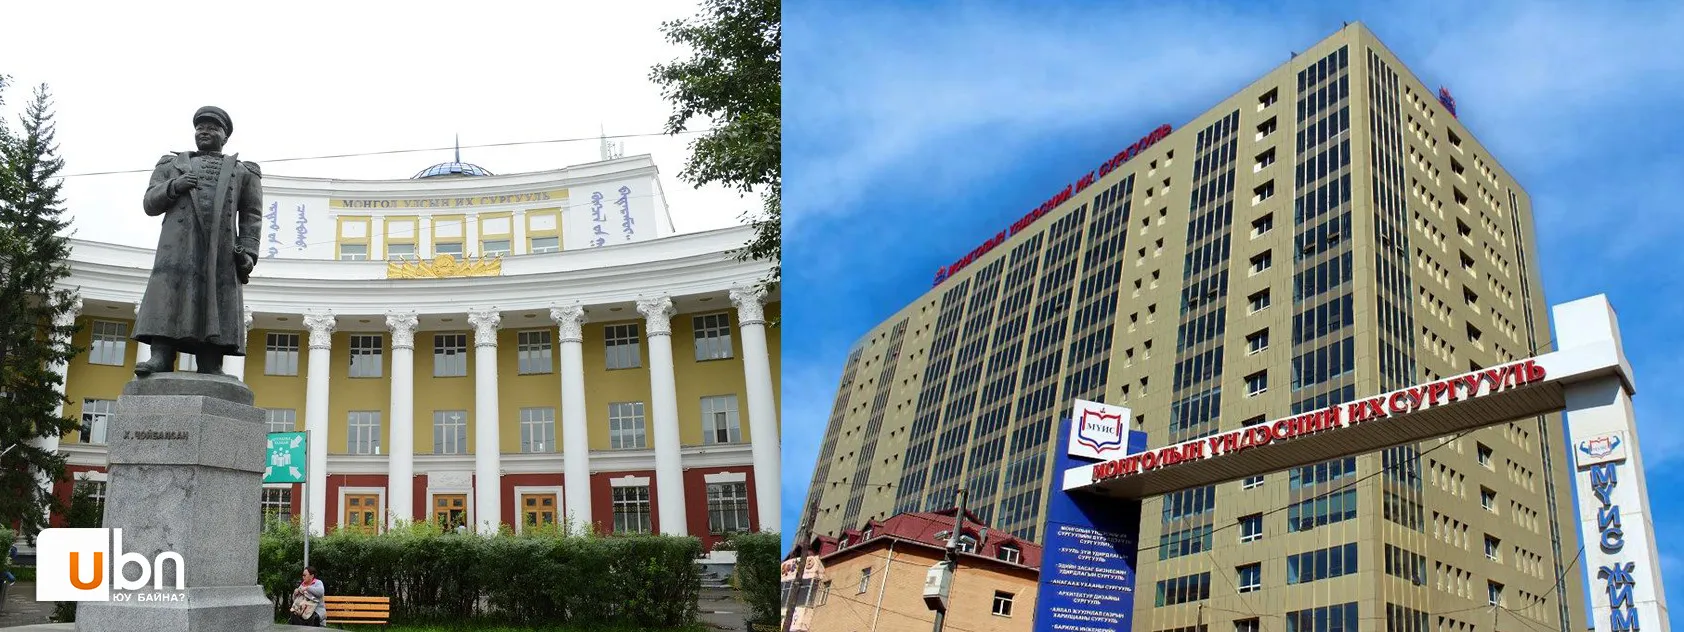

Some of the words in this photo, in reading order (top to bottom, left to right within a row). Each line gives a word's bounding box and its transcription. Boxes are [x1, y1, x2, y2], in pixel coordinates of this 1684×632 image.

[343, 199, 397, 209] МОНГОЛ
[404, 198, 449, 208] УЛСЫН
[455, 197, 474, 207] ИХ
[480, 192, 550, 205] СУРГУУЛЬ
[947, 230, 1006, 276] МОНГОЛЫН
[1075, 170, 1095, 194] ИХ
[1099, 123, 1173, 177] СУРГУУЛЬ
[1092, 440, 1206, 482] МОНГОЛЫН
[1209, 403, 1343, 455] ҮНДЭСНИЙ
[1348, 396, 1388, 424] ИХ
[1388, 359, 1547, 414] СУРГУУЛЬ
[1105, 584, 1132, 592] СУРГУУЛЬ
[1597, 562, 1640, 632] ЖИМ
[1090, 616, 1118, 624] СУРГУУЛЬ
